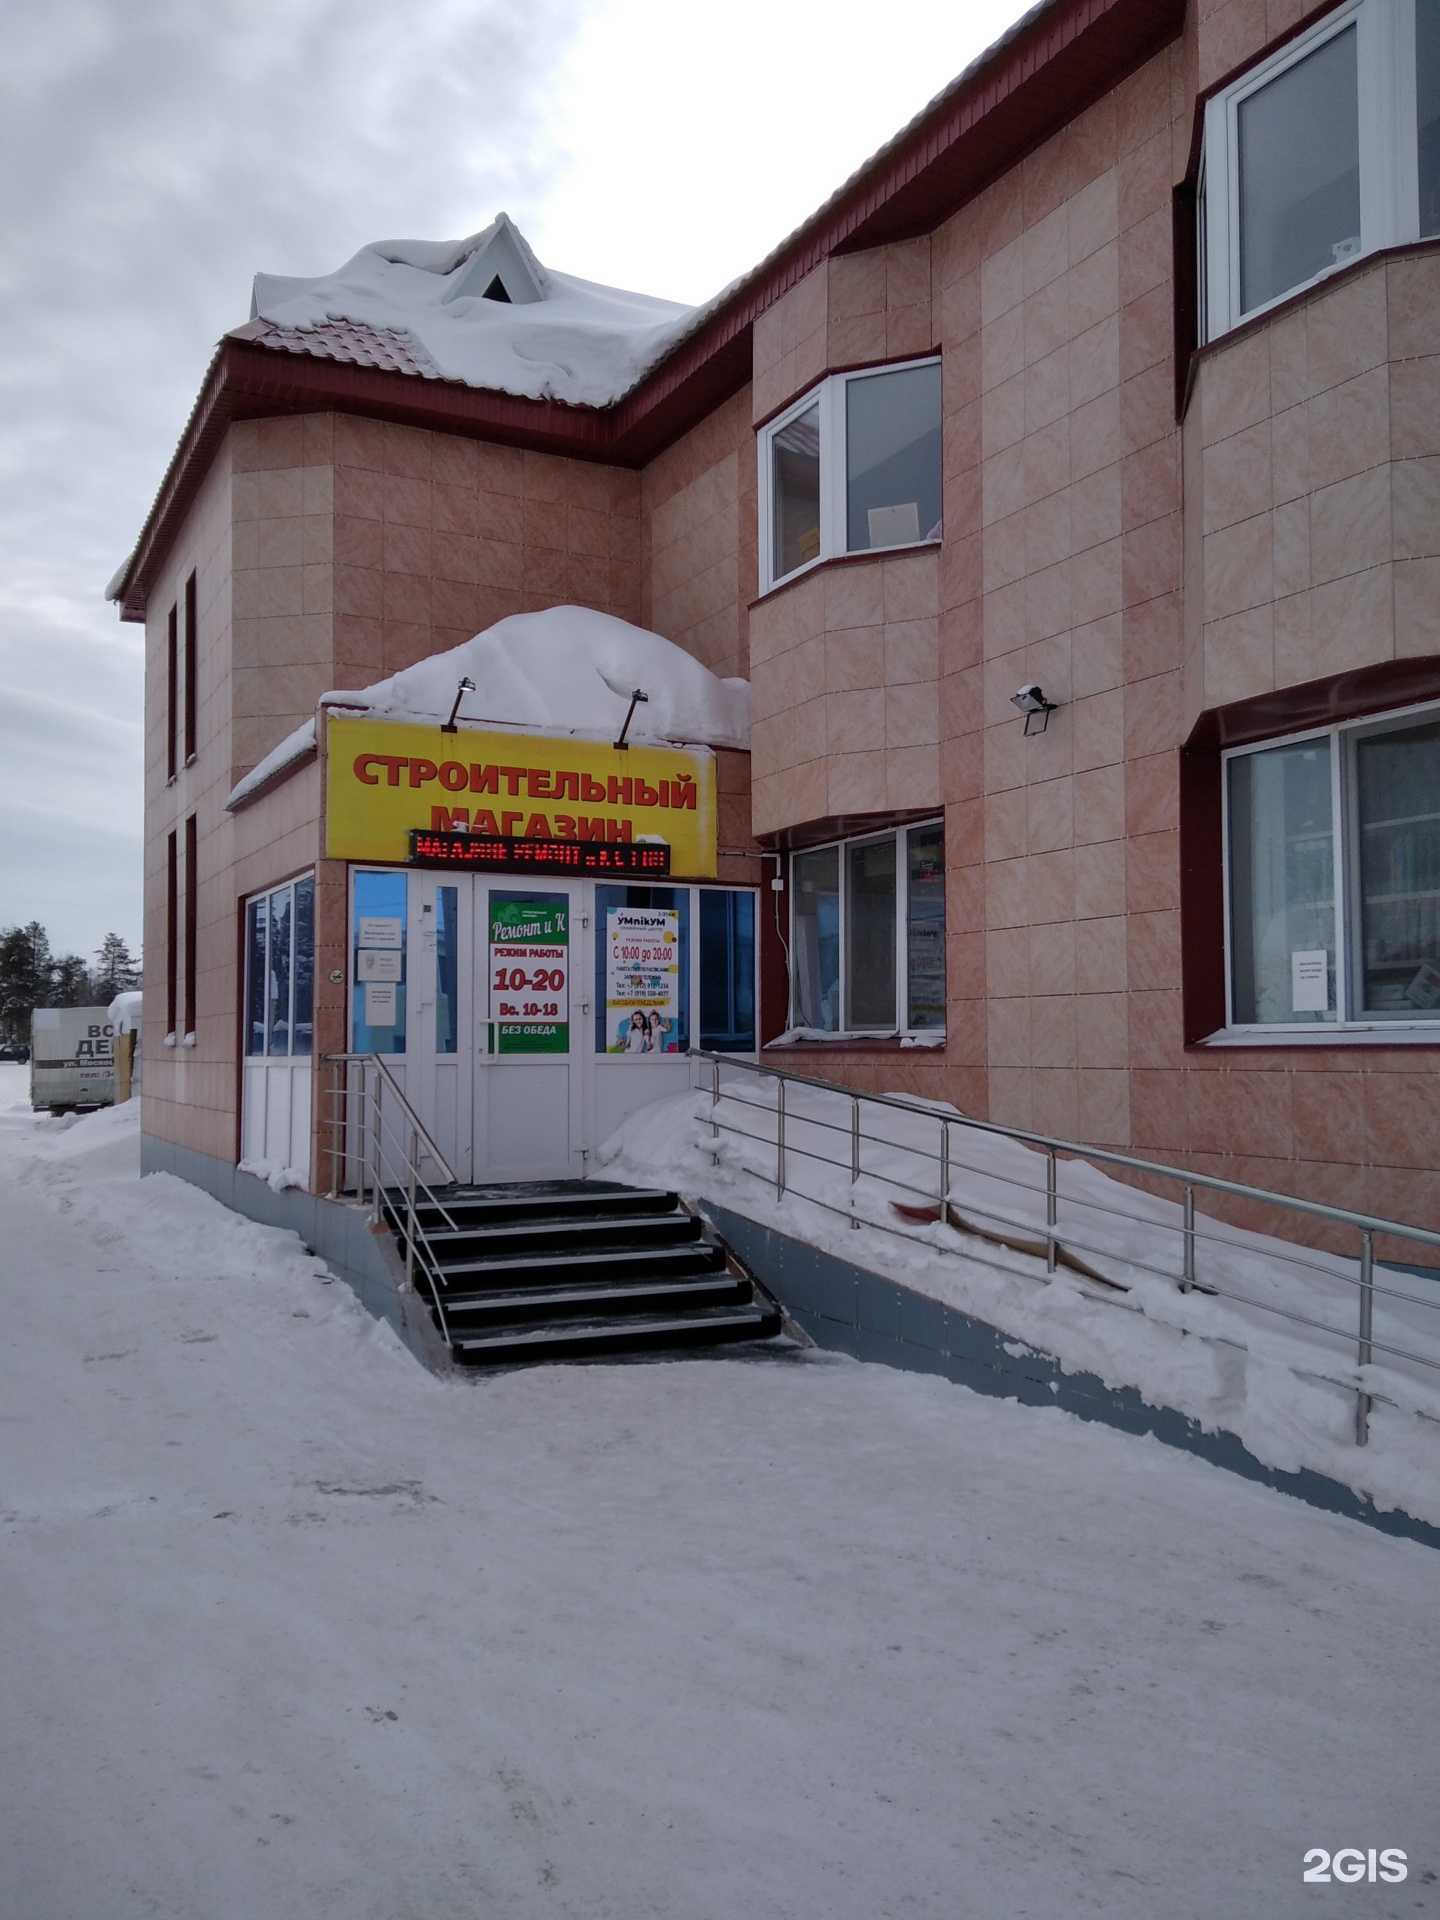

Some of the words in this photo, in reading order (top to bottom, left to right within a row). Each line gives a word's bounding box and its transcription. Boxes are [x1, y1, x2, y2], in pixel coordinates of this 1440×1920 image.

[353, 753, 697, 810] СТРОИТЕЛЬНЫЙ
[430, 805, 633, 843] МАГАЗИН
[493, 921, 541, 941] Ремонт
[544, 923, 552, 933] и
[494, 948, 527, 958] РЕЖИМ
[529, 949, 563, 958] РАБОТЫ
[493, 967, 565, 991] 10-20
[500, 1002, 519, 1016] Вс.
[523, 1002, 558, 1016] 10-18
[502, 1025, 521, 1035] БЕЗ
[523, 1025, 556, 1035] ОБЕДА
[76, 1040, 112, 1058] ДЕ
